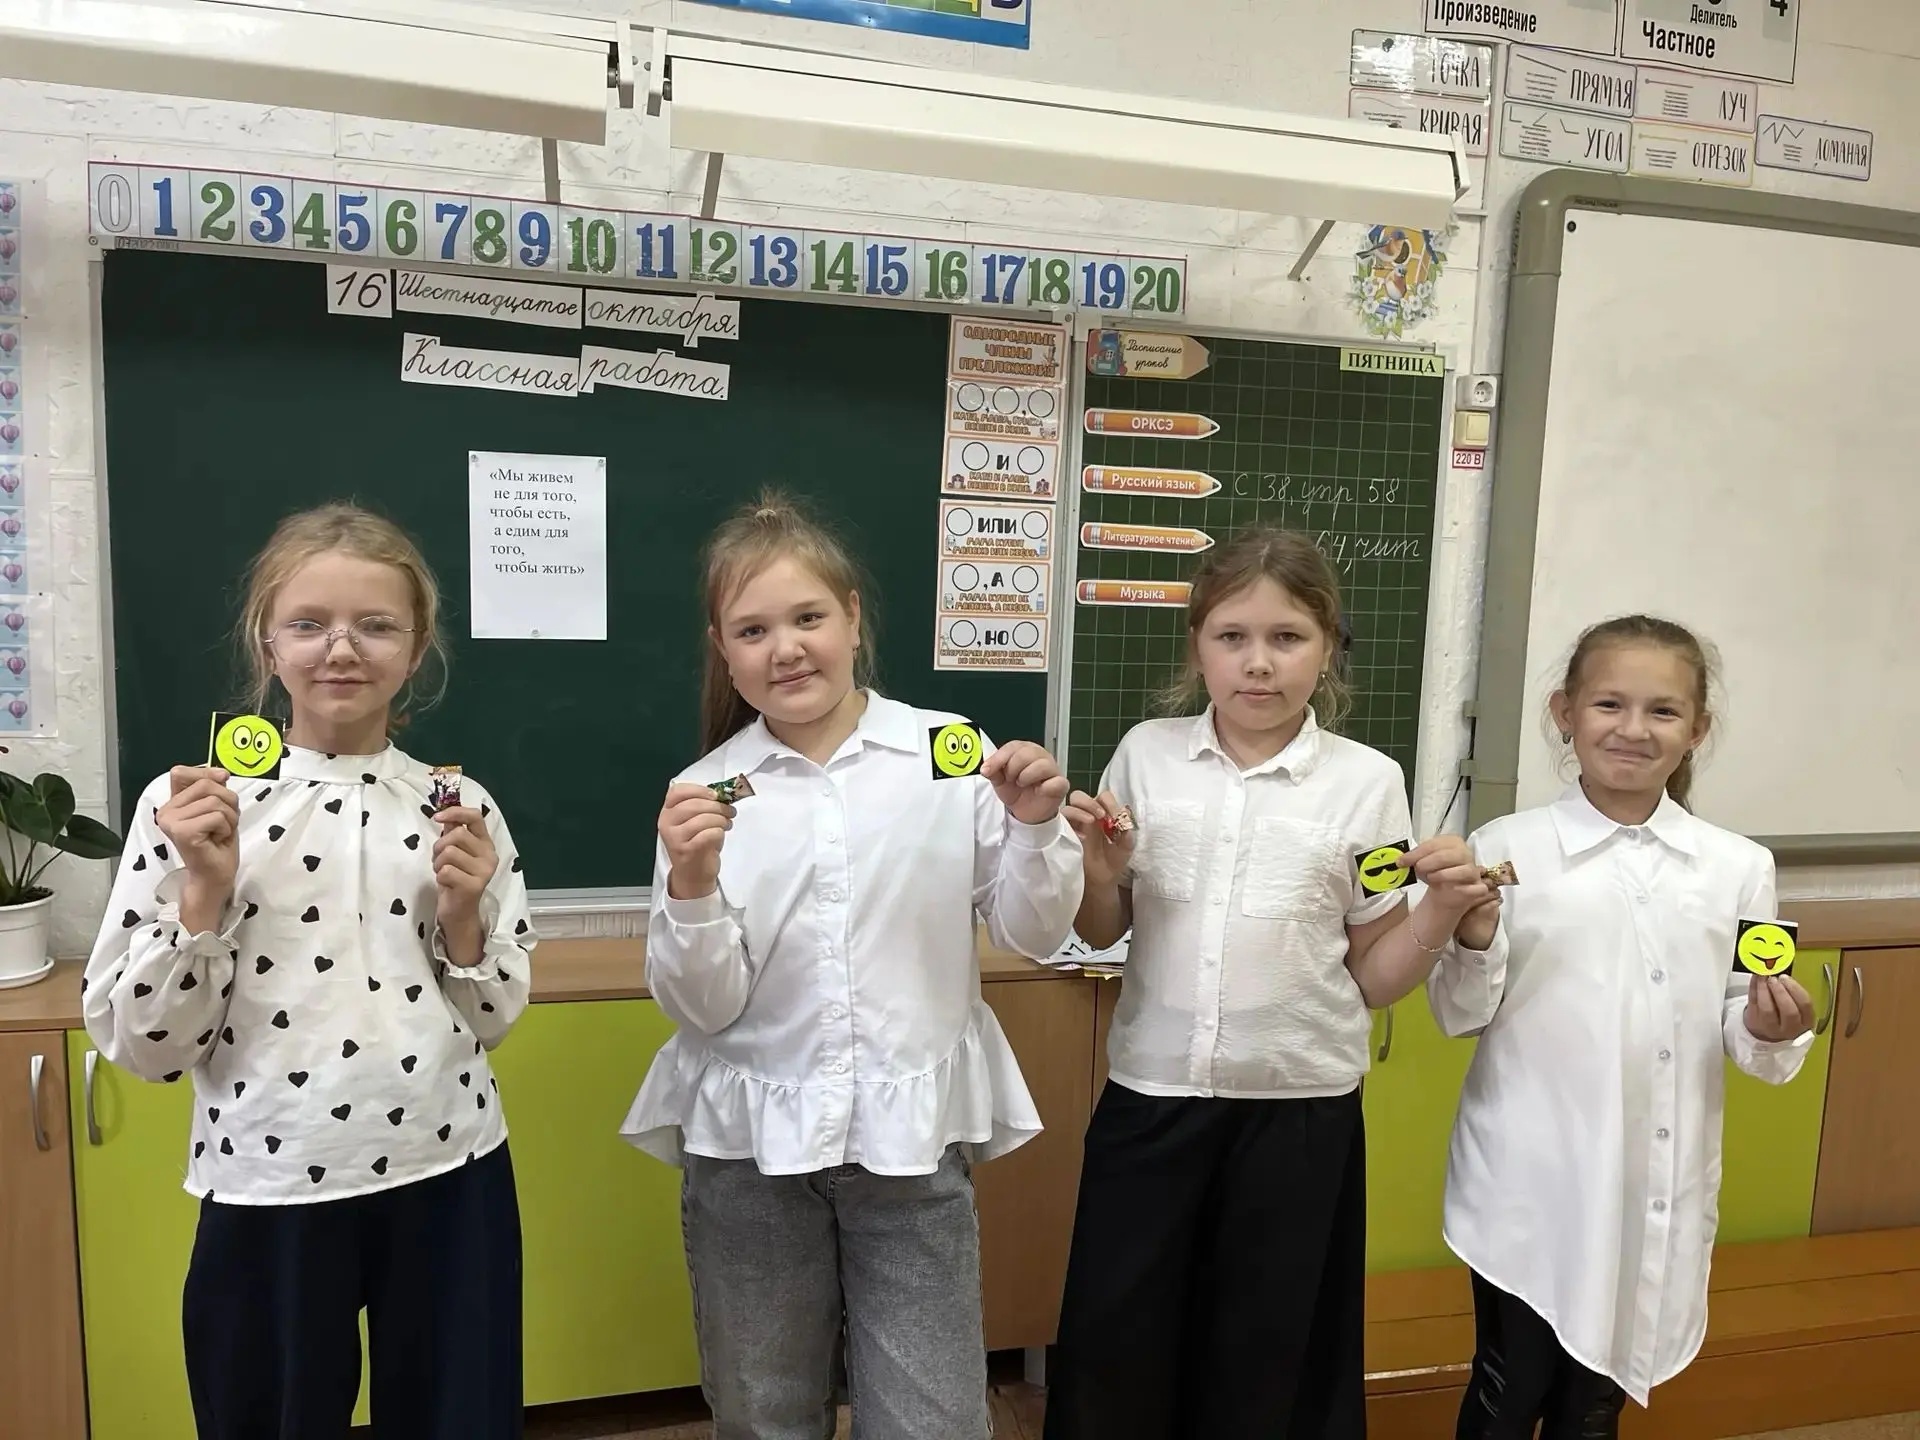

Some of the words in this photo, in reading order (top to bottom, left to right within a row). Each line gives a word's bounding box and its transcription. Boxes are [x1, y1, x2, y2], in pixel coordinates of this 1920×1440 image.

[1434, 0, 1537, 34] Произведение
[1690, 4, 1738, 28] Делитель
[1642, 20, 1716, 59] Частное
[1430, 50, 1480, 88] ТОЧКА
[1570, 69, 1632, 109] ПРЯМАЯ
[1718, 90, 1748, 122] ЛУЧ
[1420, 108, 1482, 145] КРИВАЯ
[1584, 127, 1622, 162] УГОЛ
[1815, 137, 1868, 167] ЛОМАНАЯ
[1692, 142, 1746, 173] ОТРЕЗОК
[98, 174, 132, 233] 0
[154, 177, 178, 236] 1
[200, 182, 236, 241] 2
[250, 185, 286, 243] 3
[294, 192, 330, 248] 4
[339, 195, 370, 252] 5
[386, 200, 417, 255] 6
[436, 203, 468, 259] 7
[473, 209, 507, 264] 8
[518, 212, 550, 266] 9
[567, 217, 616, 275] 10
[636, 223, 678, 279] 11
[690, 228, 738, 284] 12
[749, 236, 798, 288] 13
[810, 240, 859, 292] 14
[865, 244, 909, 296] 15
[924, 249, 968, 301] 16
[982, 254, 1027, 304] 17
[1028, 256, 1072, 306] 18
[1081, 262, 1126, 310] 19
[1134, 266, 1180, 313] 20
[336, 271, 386, 308] 16
[399, 272, 578, 315] Шестнадцатое
[588, 295, 736, 345] октября.
[963, 325, 1056, 346] ОДНОРОДНЫЕ
[985, 343, 1033, 360] ЧЛЕНЫ
[1126, 339, 1182, 354] Расписание
[404, 337, 577, 392] Классная
[580, 351, 724, 399] работа.
[1135, 357, 1170, 371] уроков
[1348, 353, 1436, 373] ПЯТНИЦА
[1131, 416, 1174, 430] ОРКСЭ
[996, 454, 1010, 471] И
[1456, 453, 1472, 464] 220
[1474, 454, 1481, 464] В
[489, 469, 524, 482] «Мы
[528, 472, 574, 484] живем
[1112, 472, 1162, 488] Русский
[1166, 479, 1196, 490] язык
[494, 489, 510, 499] не
[514, 490, 538, 501] для
[542, 491, 577, 504] того,
[1234, 473, 1248, 496] С
[1301, 480, 1352, 522] упр
[1368, 478, 1400, 503] 58
[490, 506, 532, 518] чтобы
[537, 510, 570, 521] есть,
[494, 527, 501, 536] а
[506, 528, 540, 538] едим
[544, 528, 569, 539] для
[977, 517, 1017, 534] ИЛИ
[1104, 530, 1164, 546] Литературное
[1166, 536, 1196, 546] чтение
[490, 545, 525, 556] того,
[495, 561, 538, 574] чтобы
[542, 565, 585, 574] жить»
[1120, 586, 1166, 600] Музыка
